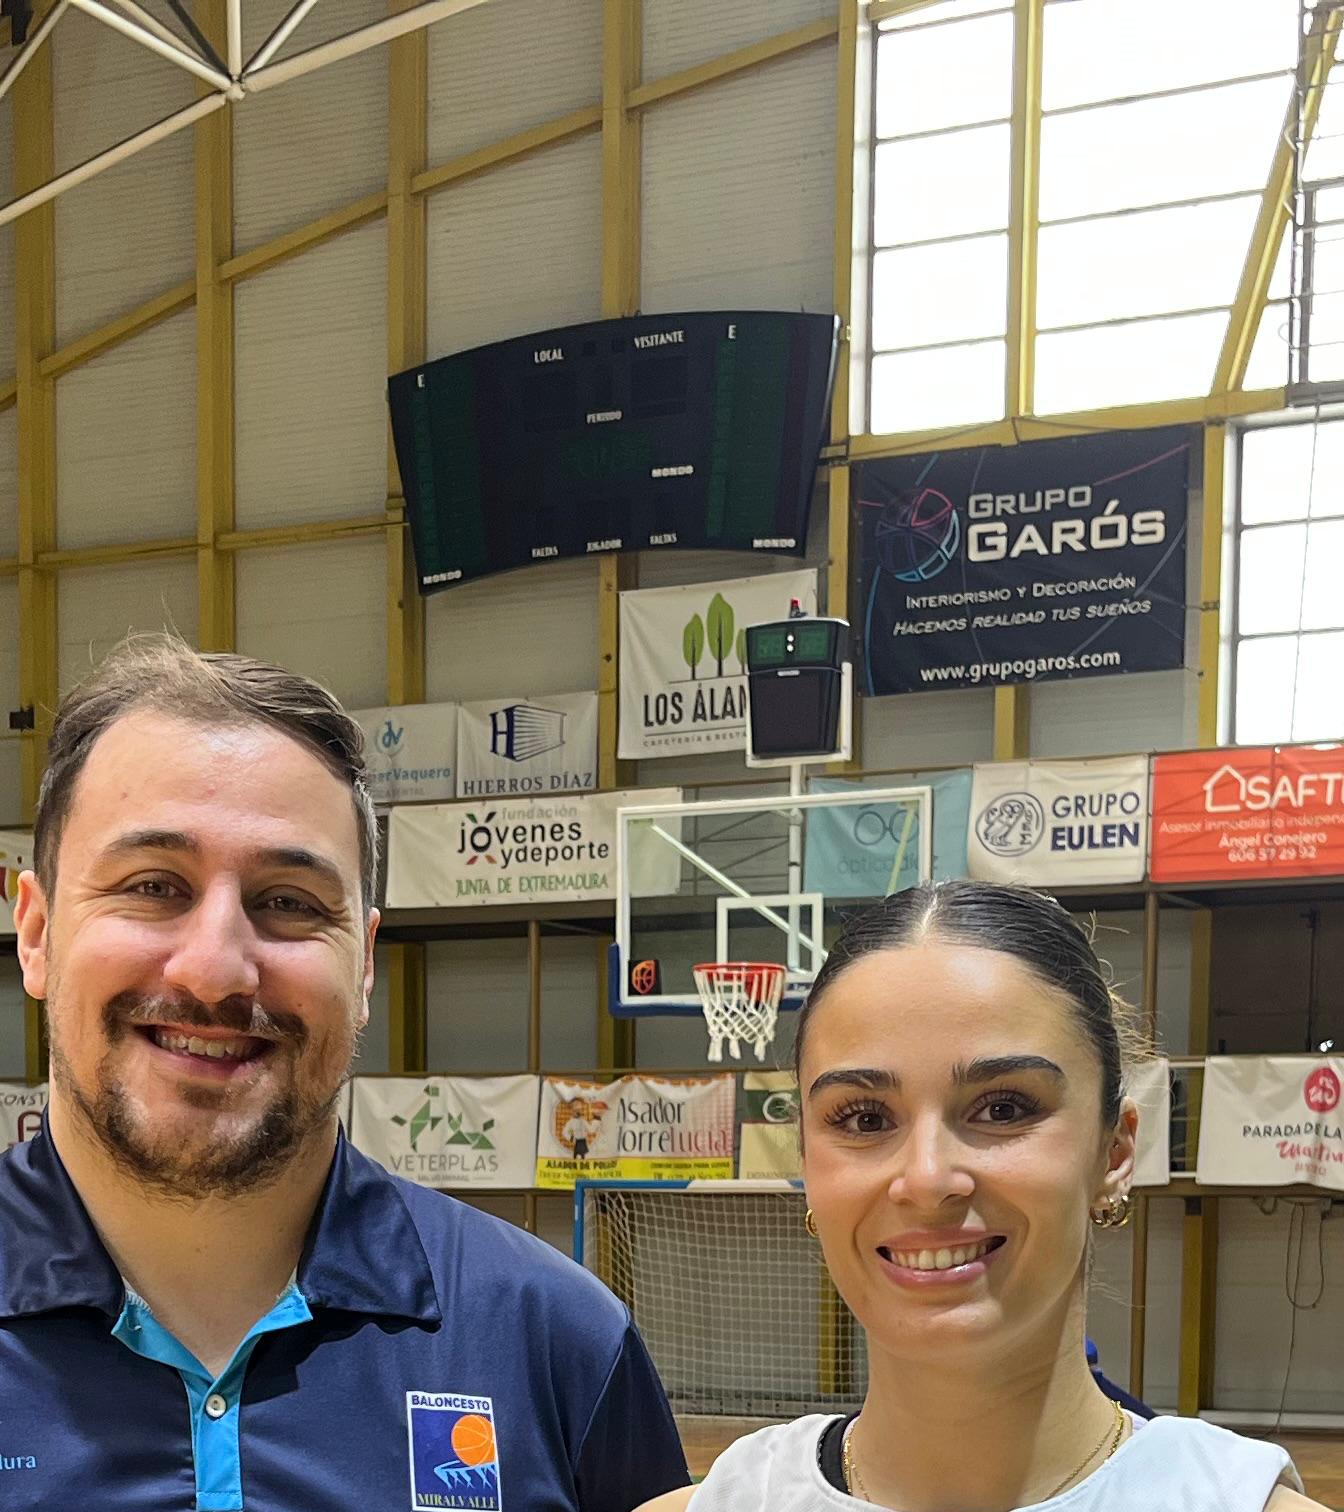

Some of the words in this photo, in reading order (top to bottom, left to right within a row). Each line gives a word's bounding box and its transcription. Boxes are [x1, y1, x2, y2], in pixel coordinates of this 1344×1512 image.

[534, 348, 564, 363] LOCAL
[634, 330, 684, 349] VISITANTE
[651, 465, 694, 479] MONDO
[753, 537, 796, 549] MONDO
[967, 499, 1166, 563] GARÓS
[423, 569, 462, 585] MONDO
[1016, 586, 1027, 598] Y
[972, 611, 1046, 629] REALIDAD
[1051, 607, 1081, 622] TUS
[1085, 594, 1152, 619] SUEÑOS
[920, 650, 1121, 683] www.grupogaros.com
[643, 691, 684, 728] LOS
[463, 775, 544, 796] HIERROS
[550, 771, 594, 790] DÍAZ
[501, 805, 578, 821] fundación
[1052, 790, 1141, 819] GRUPO
[1051, 822, 1140, 851] EULEN
[500, 841, 609, 869] ydeporte
[456, 878, 492, 898] JUNTA
[497, 878, 513, 894] DE
[519, 871, 609, 893] EXTREMADURA
[1242, 1122, 1301, 1139] PARADA
[1323, 1124, 1343, 1140] LA
[389, 1153, 499, 1173] VETERPLAS
[410, 1394, 491, 1413] BALONCESTO
